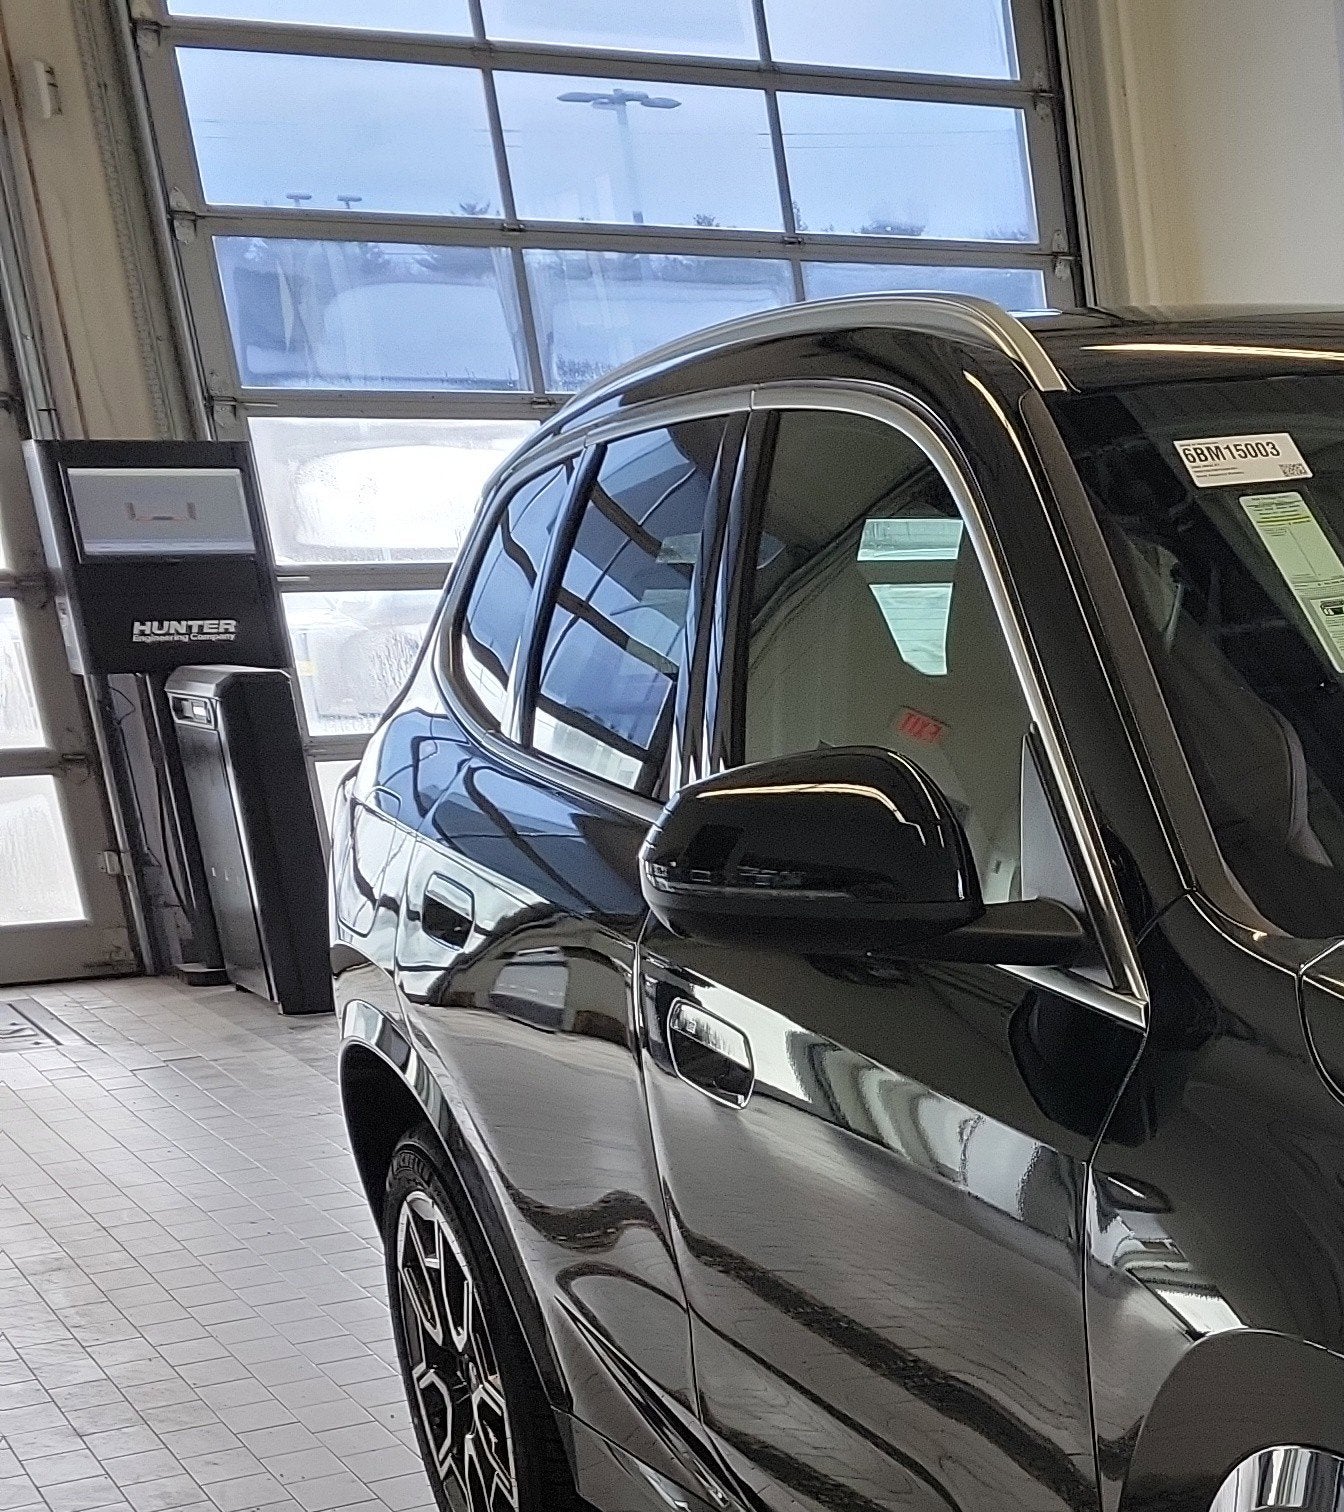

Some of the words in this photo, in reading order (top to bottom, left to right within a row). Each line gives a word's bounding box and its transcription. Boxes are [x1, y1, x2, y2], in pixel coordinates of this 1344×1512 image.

[1182, 441, 1280, 464] 6BM15003
[133, 619, 236, 635] HUNTER
[132, 633, 189, 643] Engineering
[190, 633, 236, 642] Company
